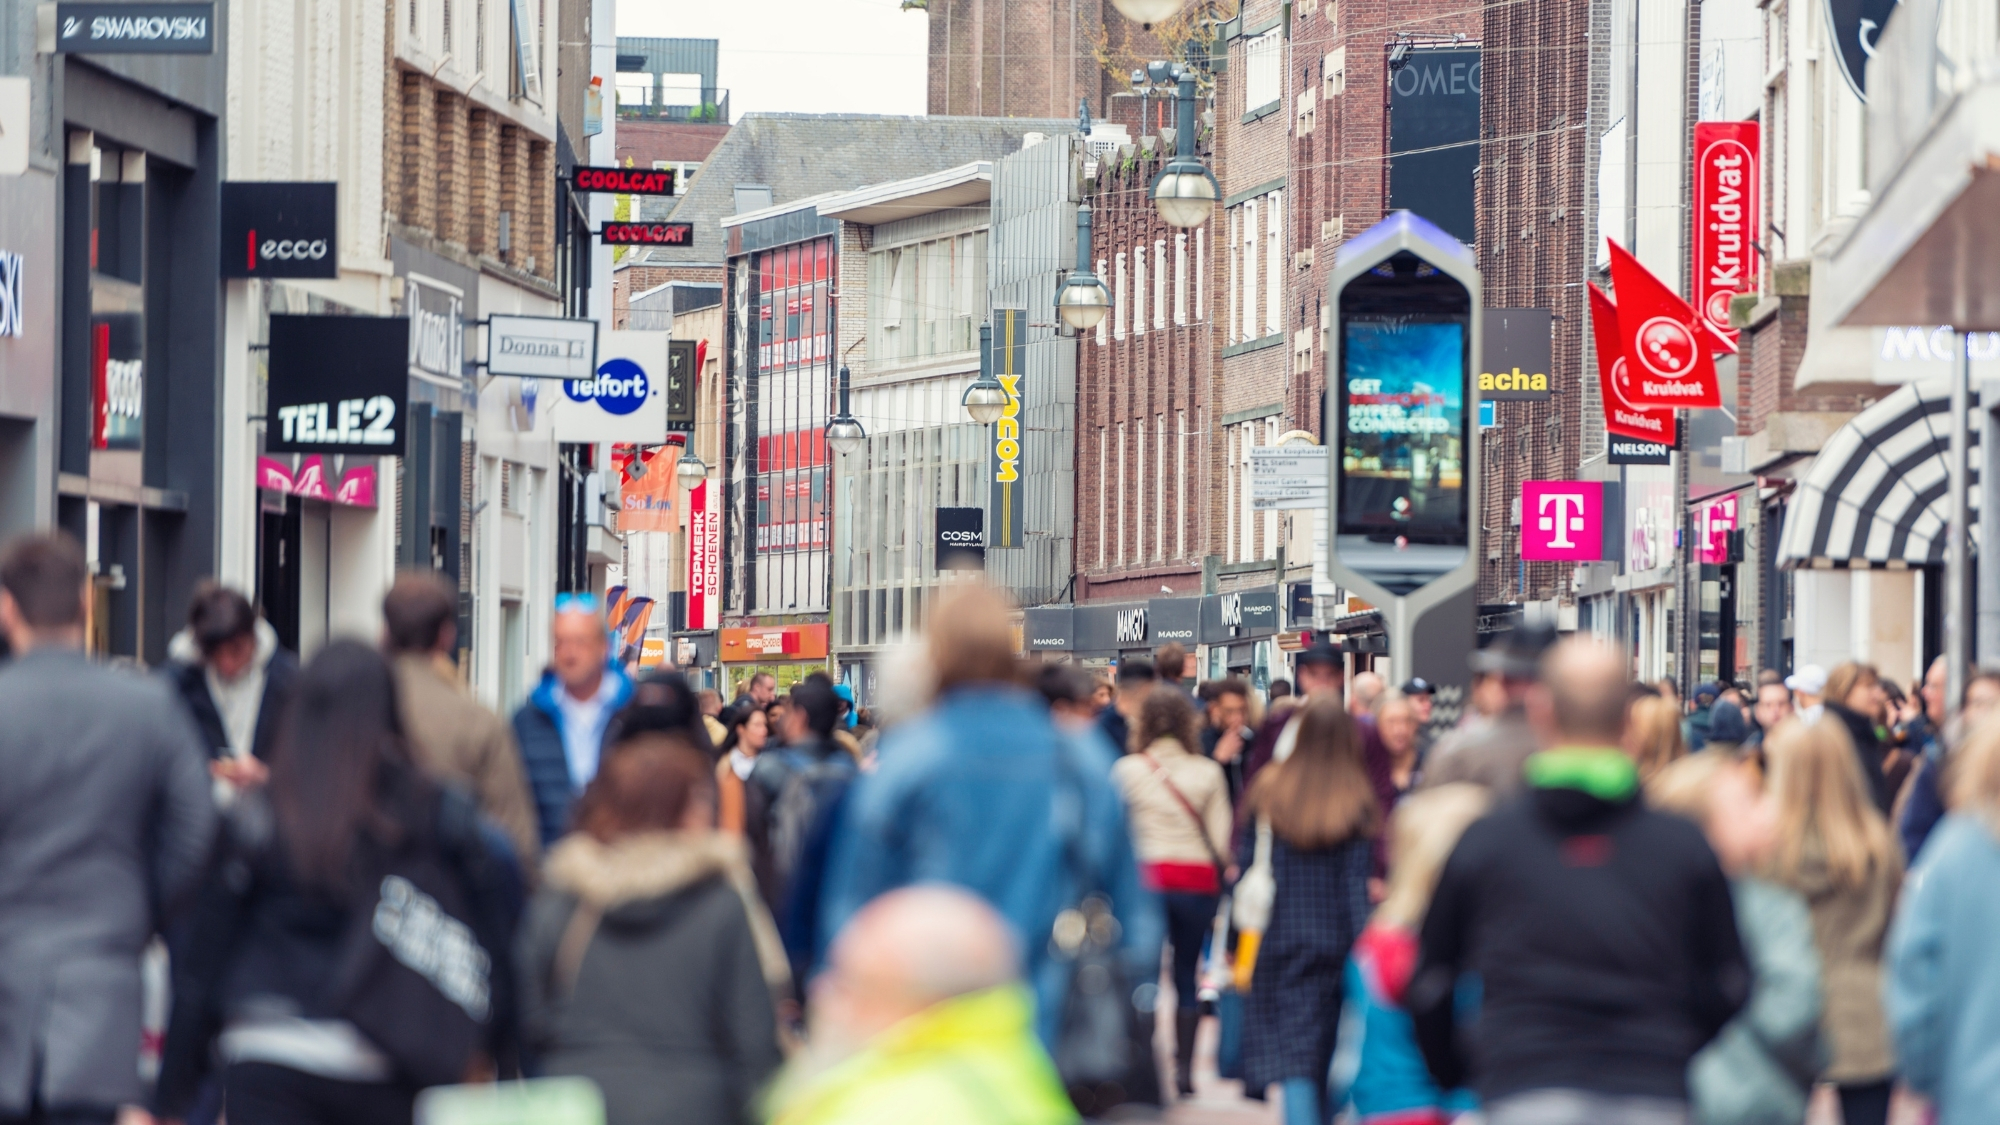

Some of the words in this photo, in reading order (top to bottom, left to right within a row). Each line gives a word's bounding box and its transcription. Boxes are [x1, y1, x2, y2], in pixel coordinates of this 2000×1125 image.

[89, 15, 206, 40] SWAROVSKI
[577, 169, 667, 192] COOLCAT
[1710, 153, 1742, 287] Kruidvat
[606, 224, 689, 243] COOLCAT
[259, 238, 328, 261] ecco
[499, 336, 560, 358] Donna
[566, 340, 586, 359] Li
[1641, 379, 1704, 397] Kruidvat
[277, 394, 396, 445] TELE2
[1614, 408, 1663, 432] Kruidvat
[1612, 442, 1667, 457] NELSON
[692, 510, 705, 597] TOPMERK
[707, 511, 719, 597] SCHOENEN
[1243, 605, 1273, 613] MANGO
[1116, 607, 1145, 643] MANGO
[1157, 629, 1193, 638] MANGO
[1033, 637, 1065, 646] MANGO
